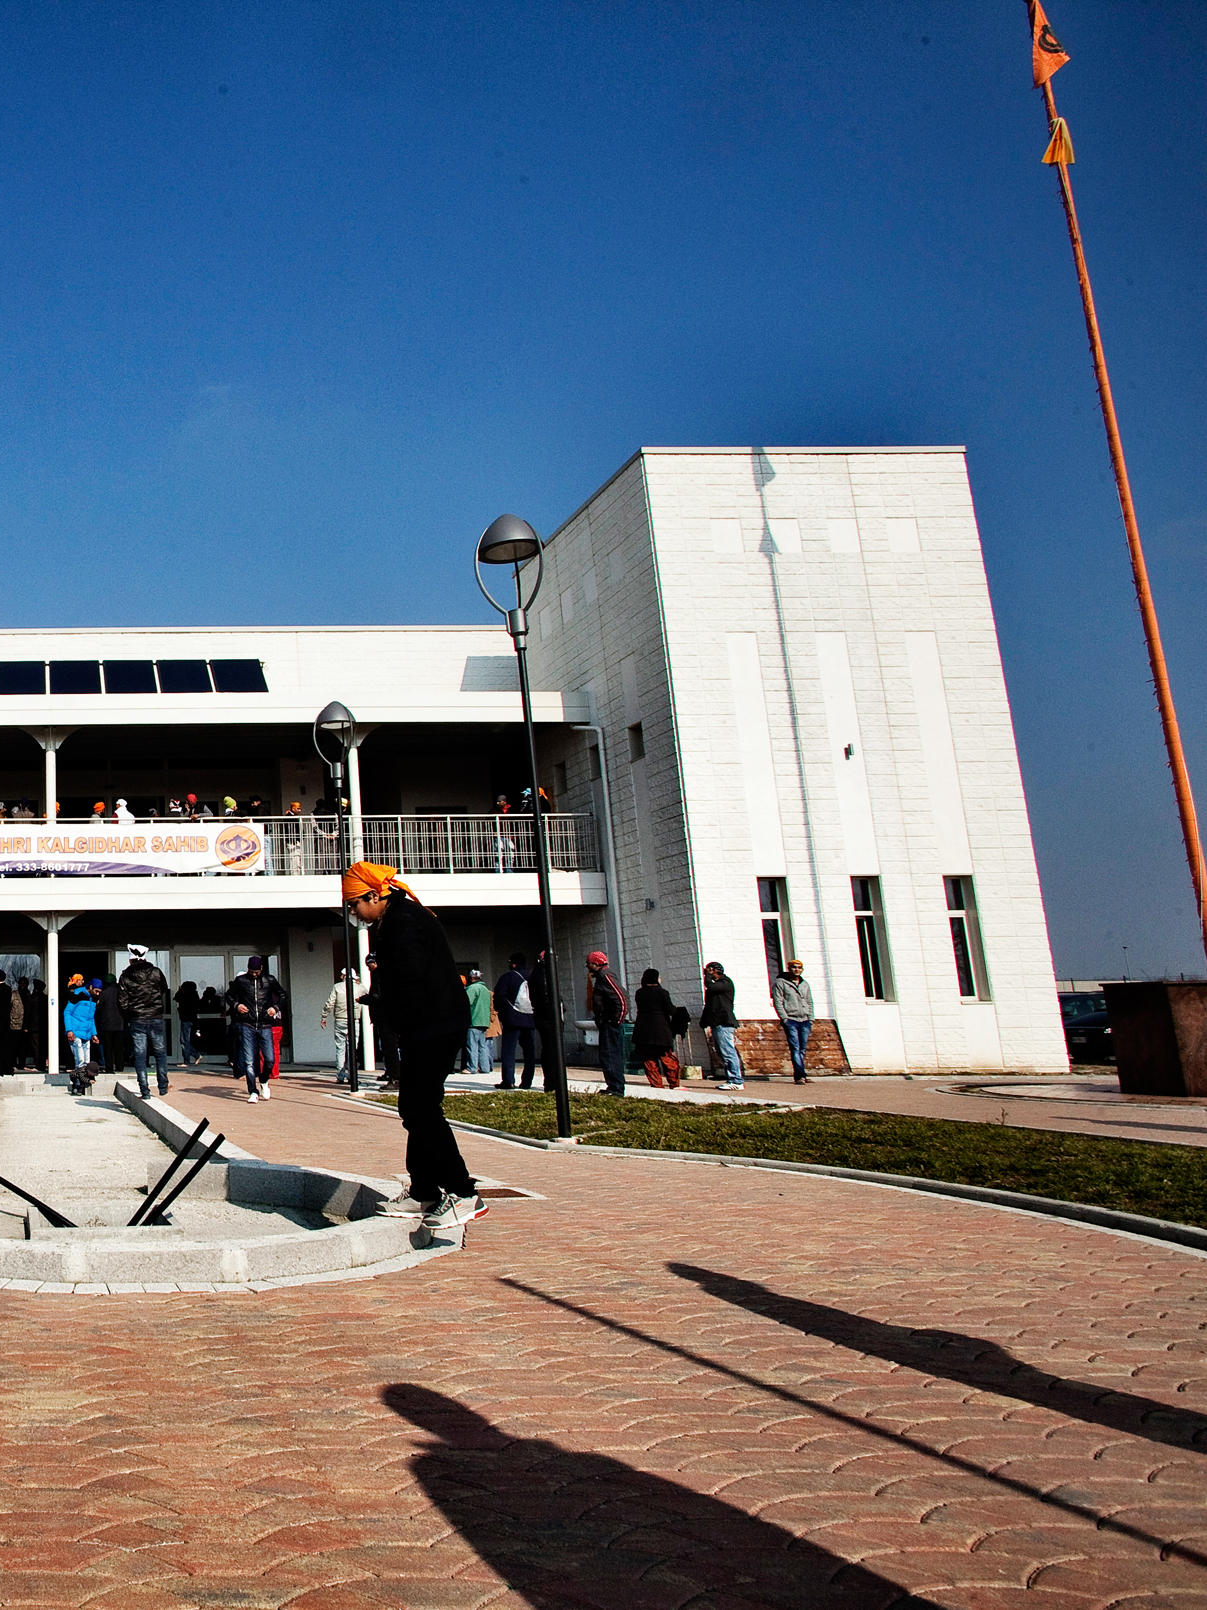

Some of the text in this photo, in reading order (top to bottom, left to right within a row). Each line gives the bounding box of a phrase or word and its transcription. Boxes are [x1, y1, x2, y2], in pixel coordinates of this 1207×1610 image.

[37, 836, 147, 853] KALGIDHAR
[151, 836, 209, 852] SAHIB
[16, 863, 90, 872] 333-8601777
